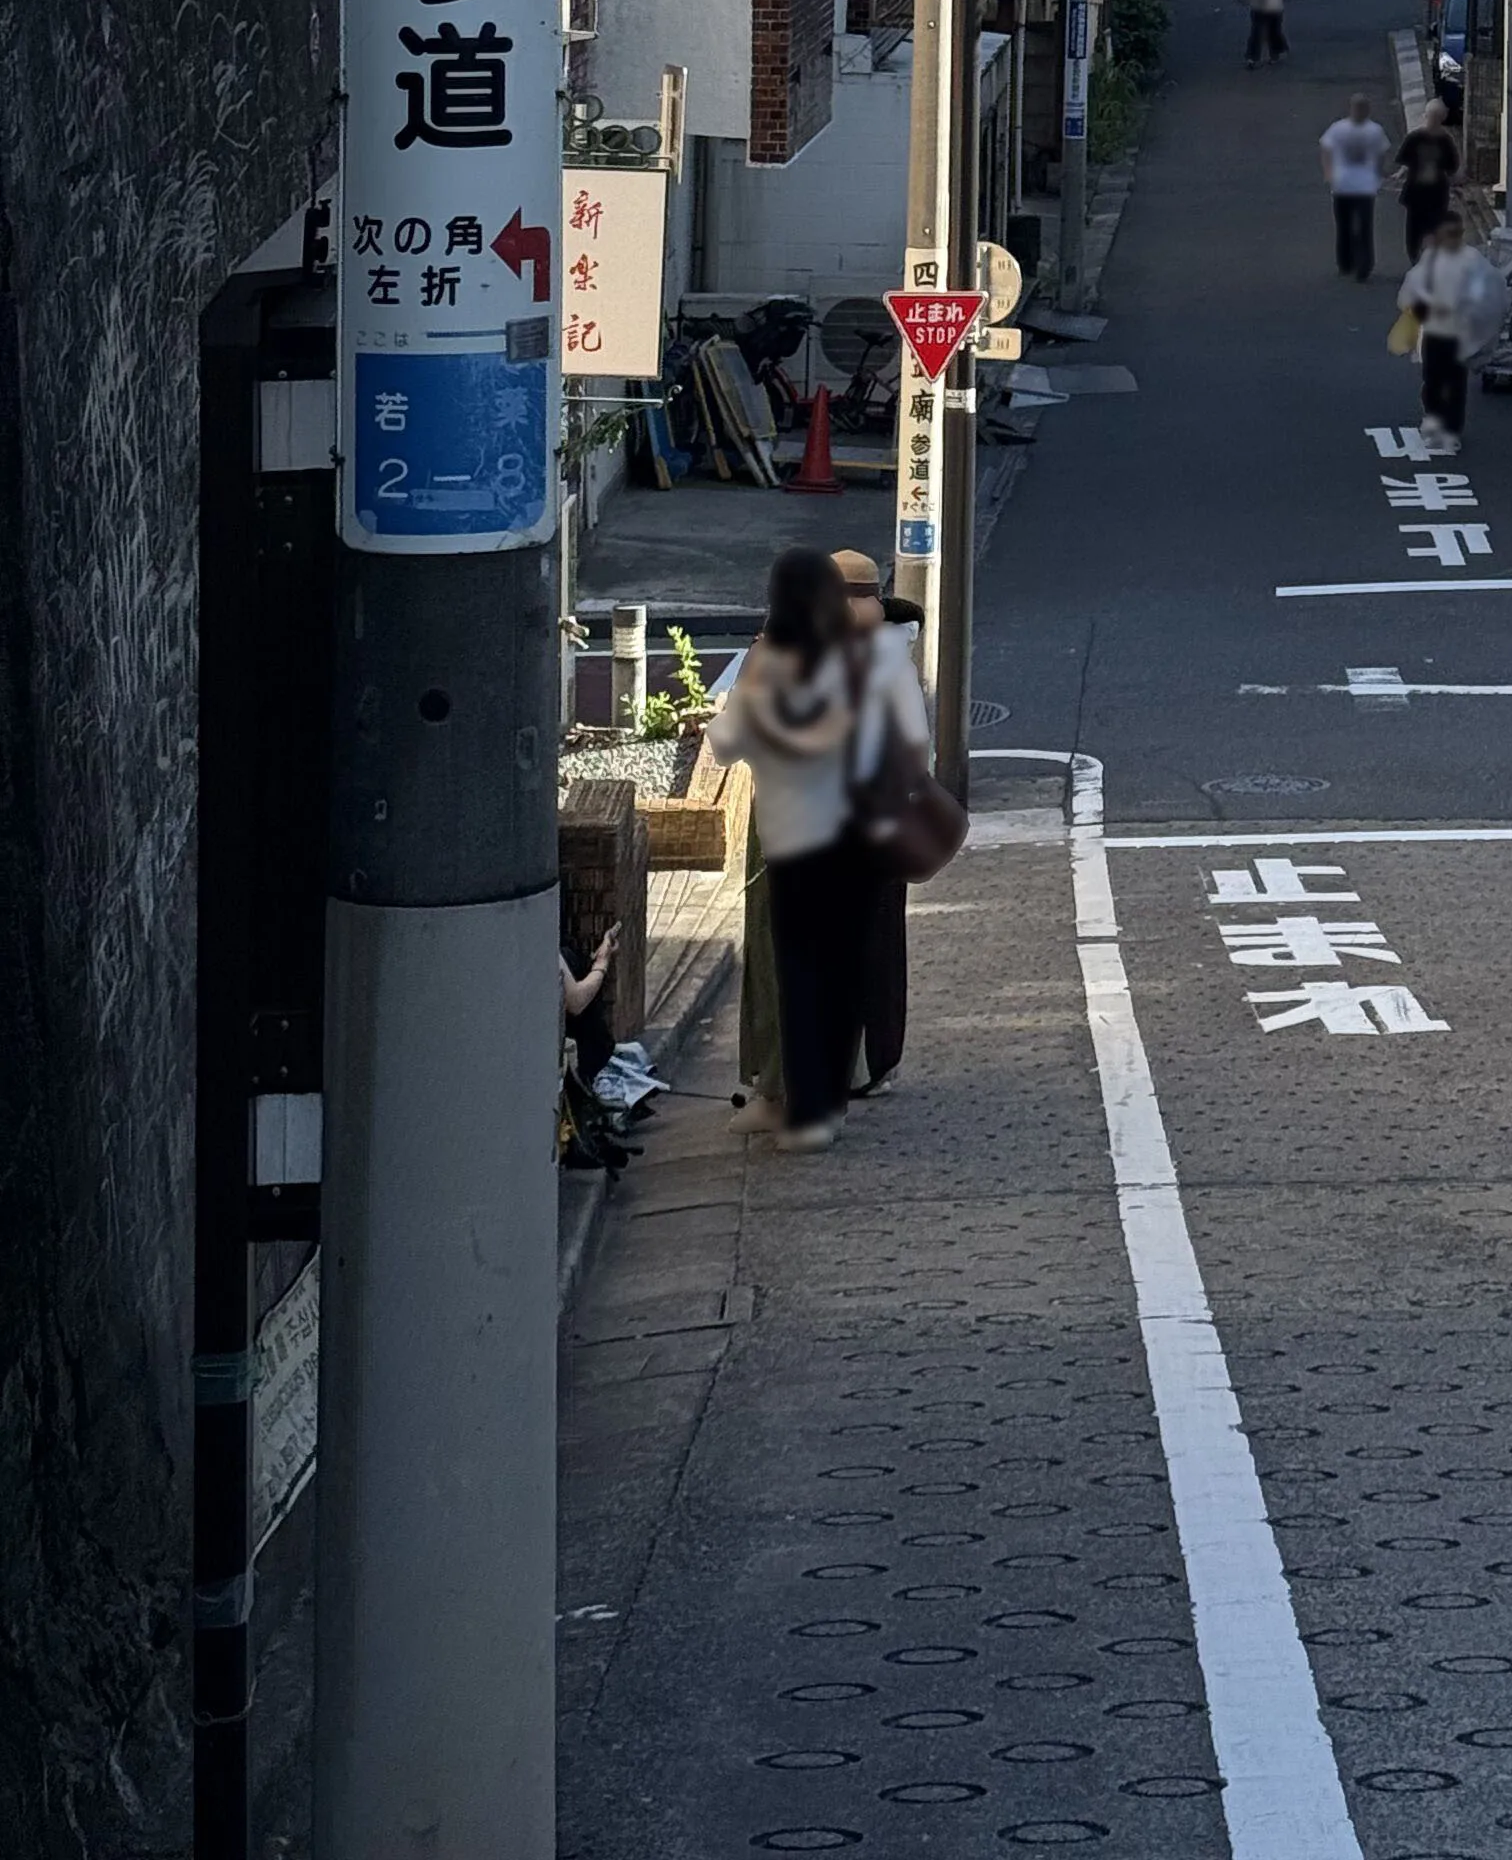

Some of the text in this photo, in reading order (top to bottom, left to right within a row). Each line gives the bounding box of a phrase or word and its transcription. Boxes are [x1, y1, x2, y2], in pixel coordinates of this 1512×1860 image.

[352, 214, 484, 257] 次の角
[367, 264, 462, 308] 左折
[561, 189, 605, 353] 新楽記
[904, 302, 966, 324] 止まれ
[355, 329, 411, 348] ここは
[915, 326, 957, 344] STOP
[908, 261, 939, 482] 四廟参道
[1207, 857, 1453, 1036] 止まれ
